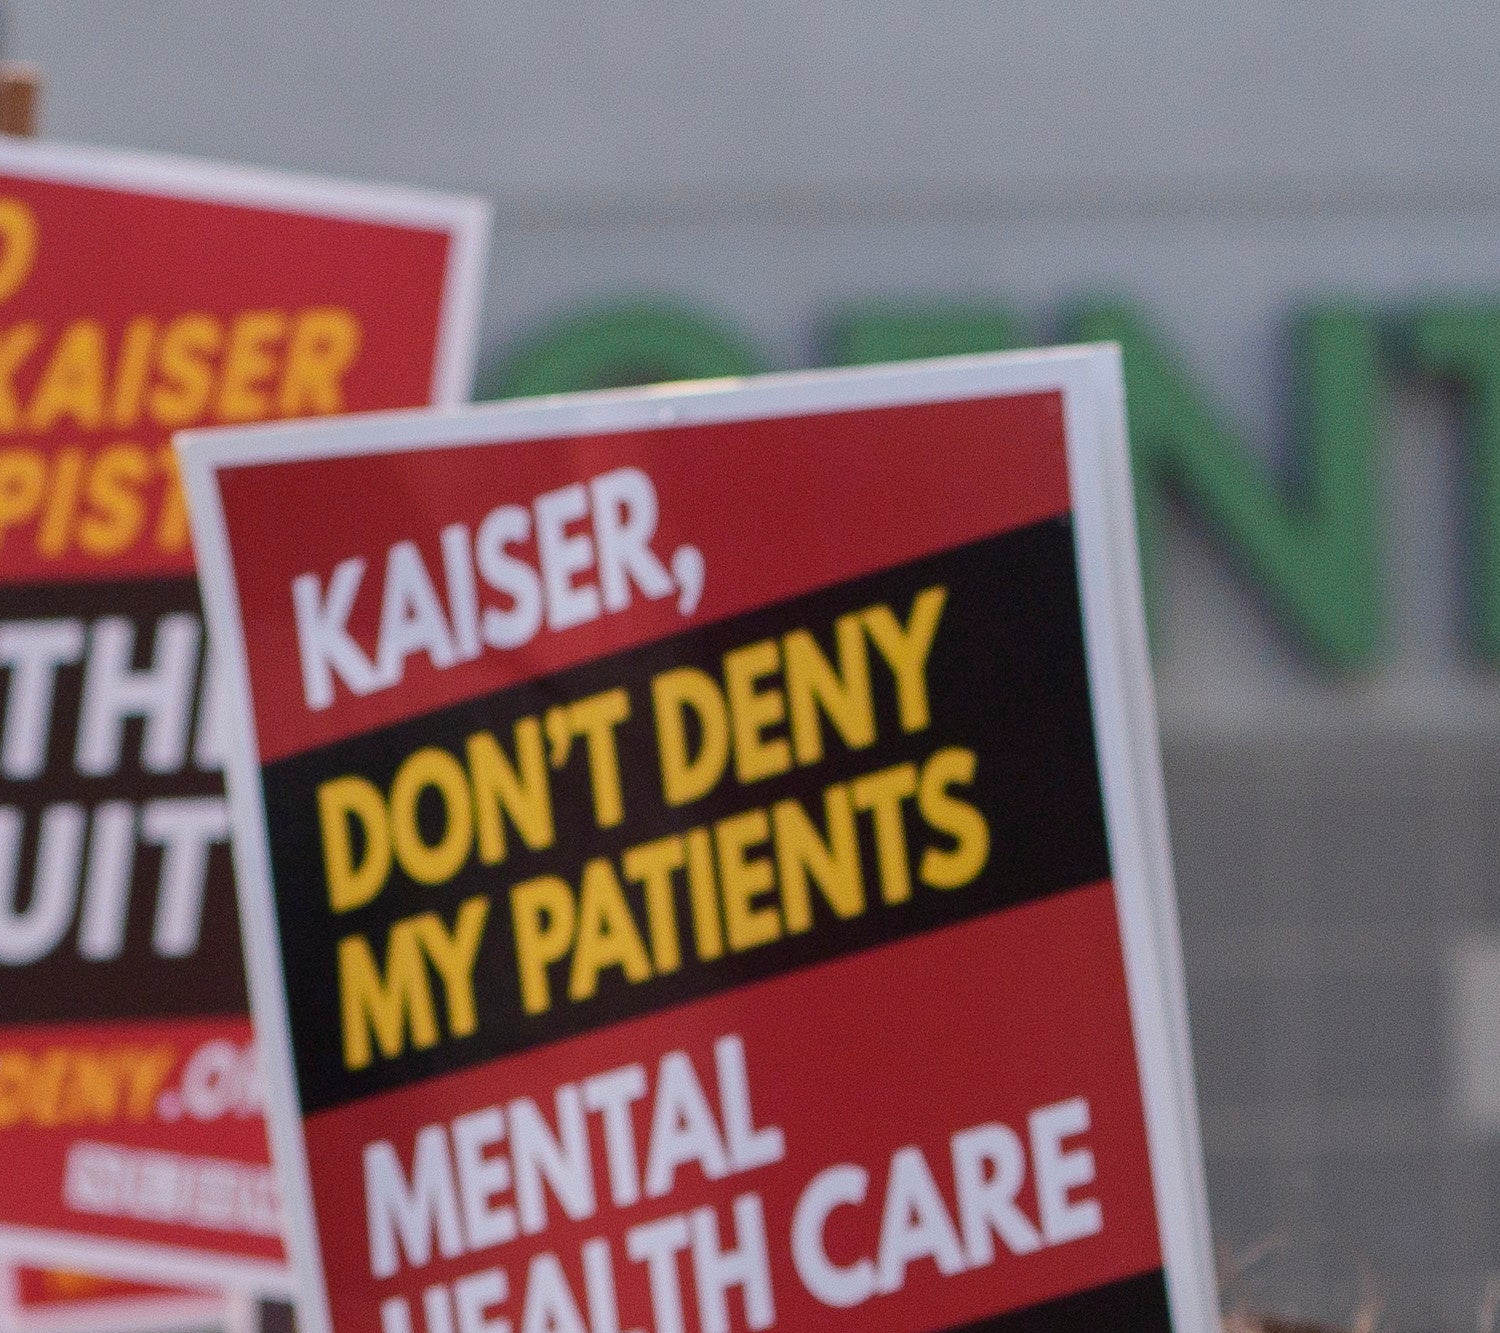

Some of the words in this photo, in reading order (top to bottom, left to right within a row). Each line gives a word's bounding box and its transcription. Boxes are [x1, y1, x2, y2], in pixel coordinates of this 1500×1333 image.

[291, 465, 706, 713] KAISER,
[316, 684, 631, 915] DON'T
[650, 585, 947, 808] DENY
[335, 894, 491, 1073] MY
[510, 743, 991, 1017] PATIENTS
[362, 1033, 787, 1280] MENTAL
[790, 1095, 1105, 1309] CARE
